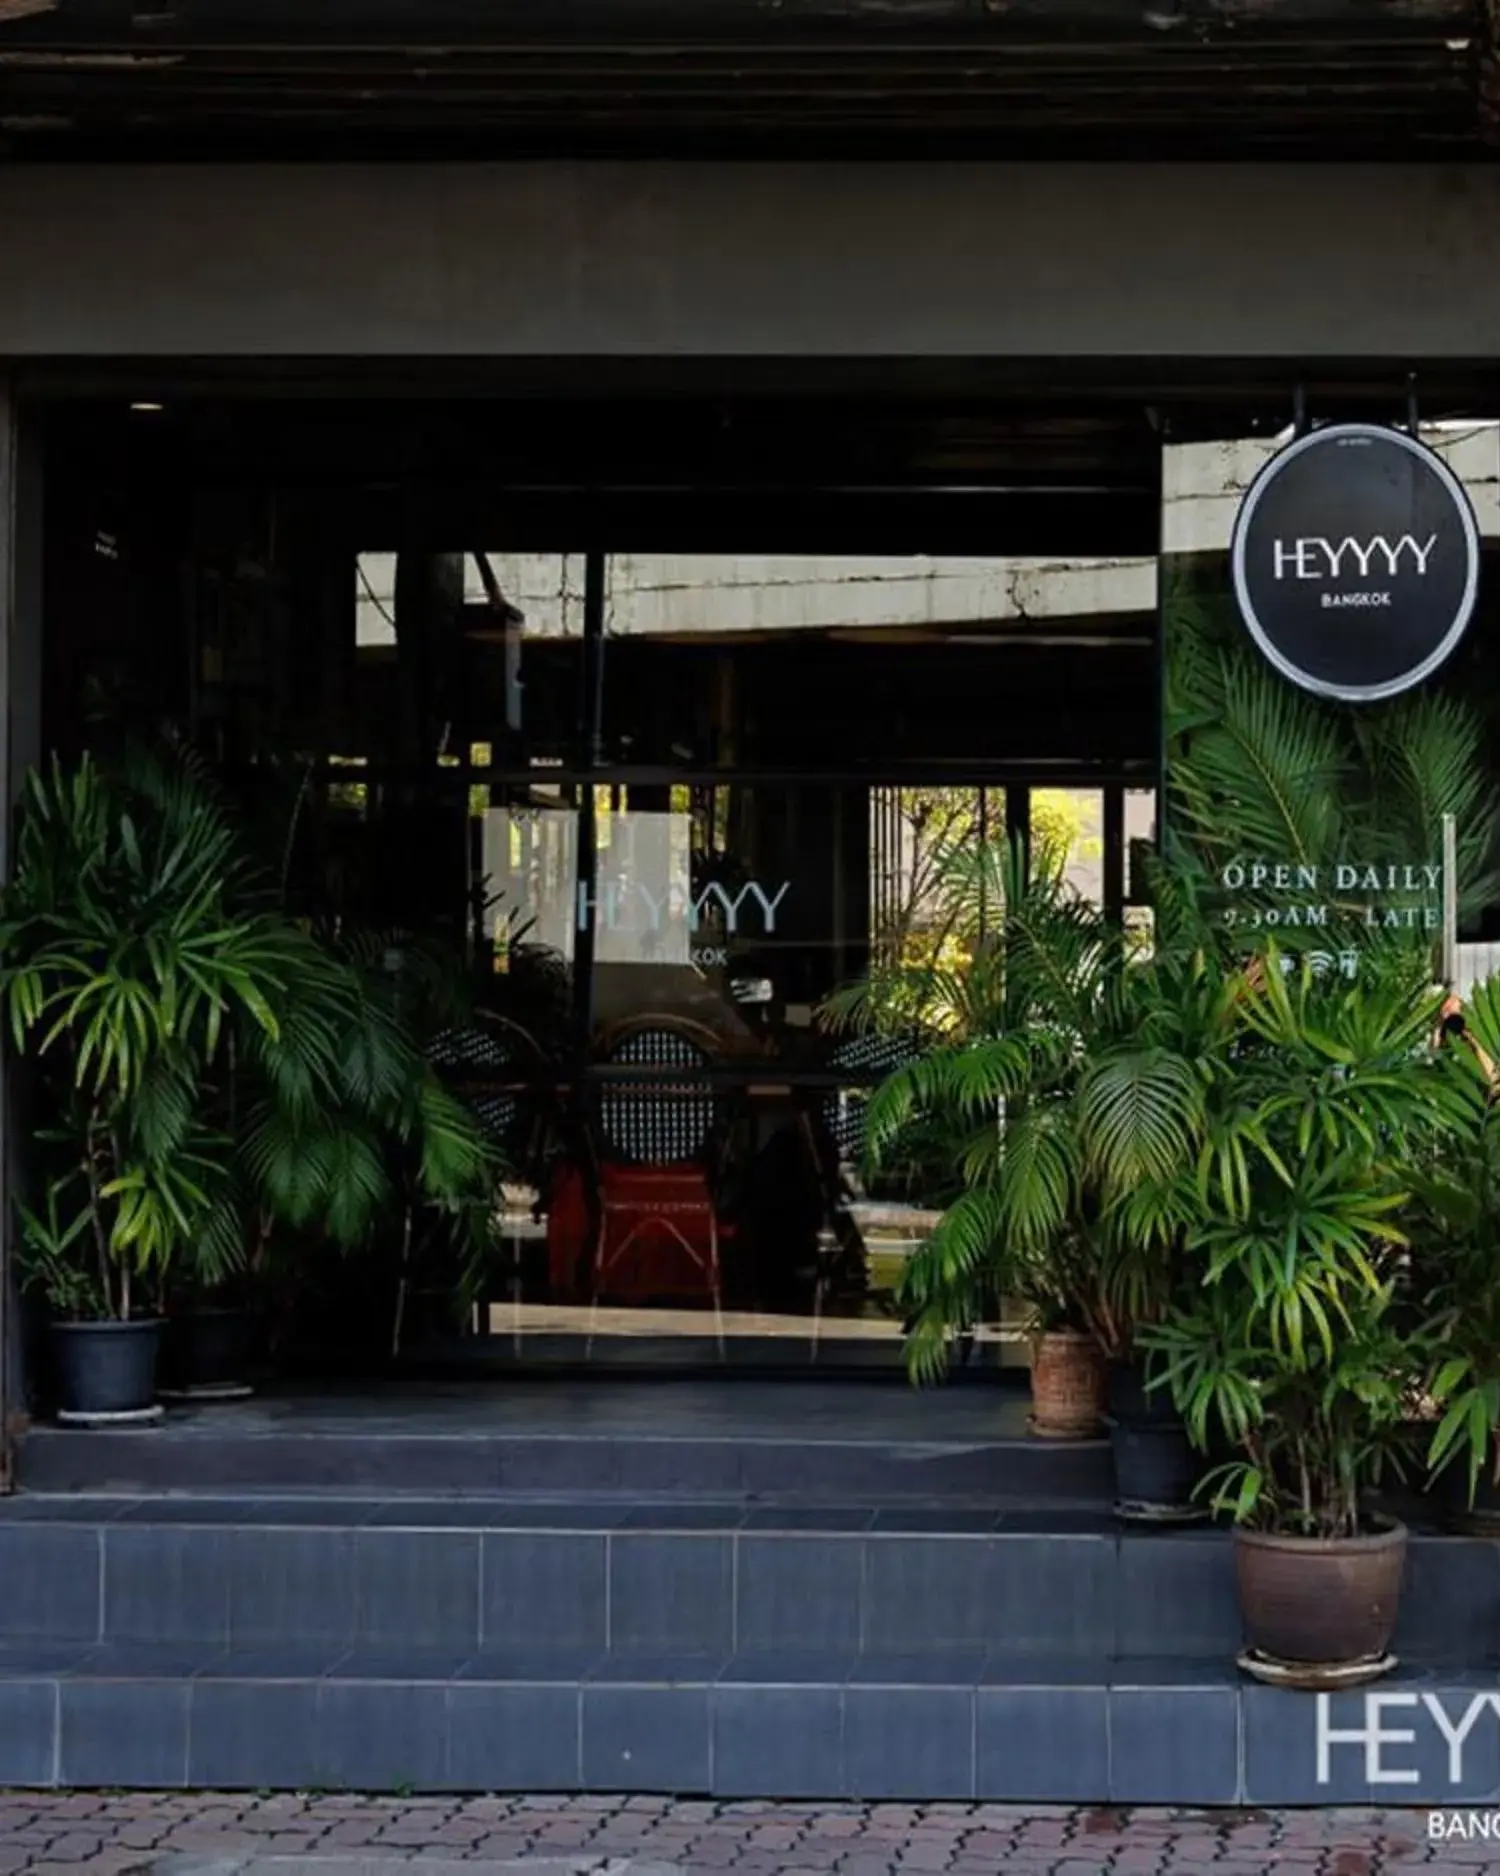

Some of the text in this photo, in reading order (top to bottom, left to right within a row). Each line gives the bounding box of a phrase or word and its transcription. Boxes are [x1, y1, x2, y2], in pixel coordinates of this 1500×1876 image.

[1273, 534, 1437, 579] HEYYYY
[1321, 593, 1392, 608] BANGKOK
[1223, 865, 1442, 889] OPEN DAILY
[1366, 907, 1441, 929] LATE
